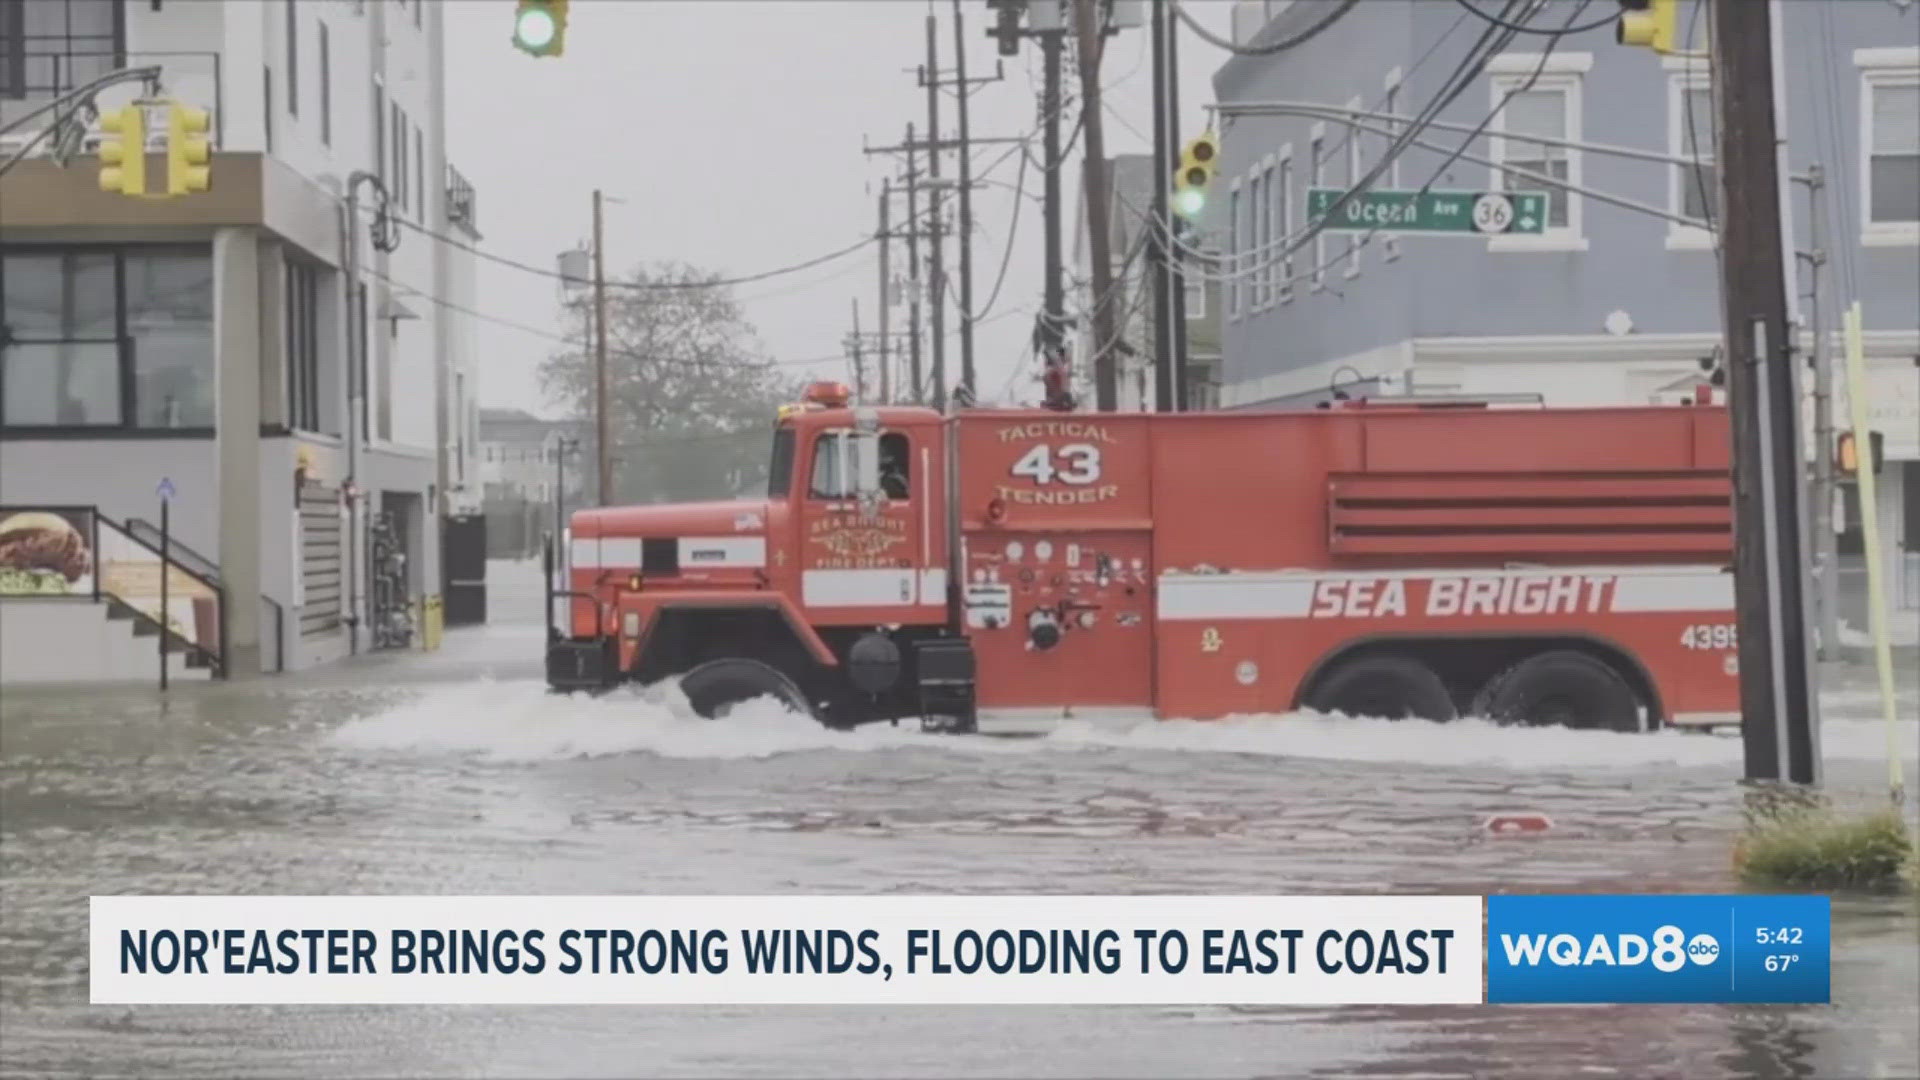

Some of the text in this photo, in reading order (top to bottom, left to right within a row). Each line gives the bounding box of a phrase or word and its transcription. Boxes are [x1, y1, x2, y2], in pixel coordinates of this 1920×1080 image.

[1347, 200, 1418, 223] Ocean
[1433, 200, 1460, 217] Ave
[1478, 202, 1507, 227] 36
[998, 422, 1117, 443] TACTICAL
[1011, 443, 1101, 485] 43
[997, 484, 1119, 505] TENDER
[1312, 574, 1613, 619] SEA BRIGHT
